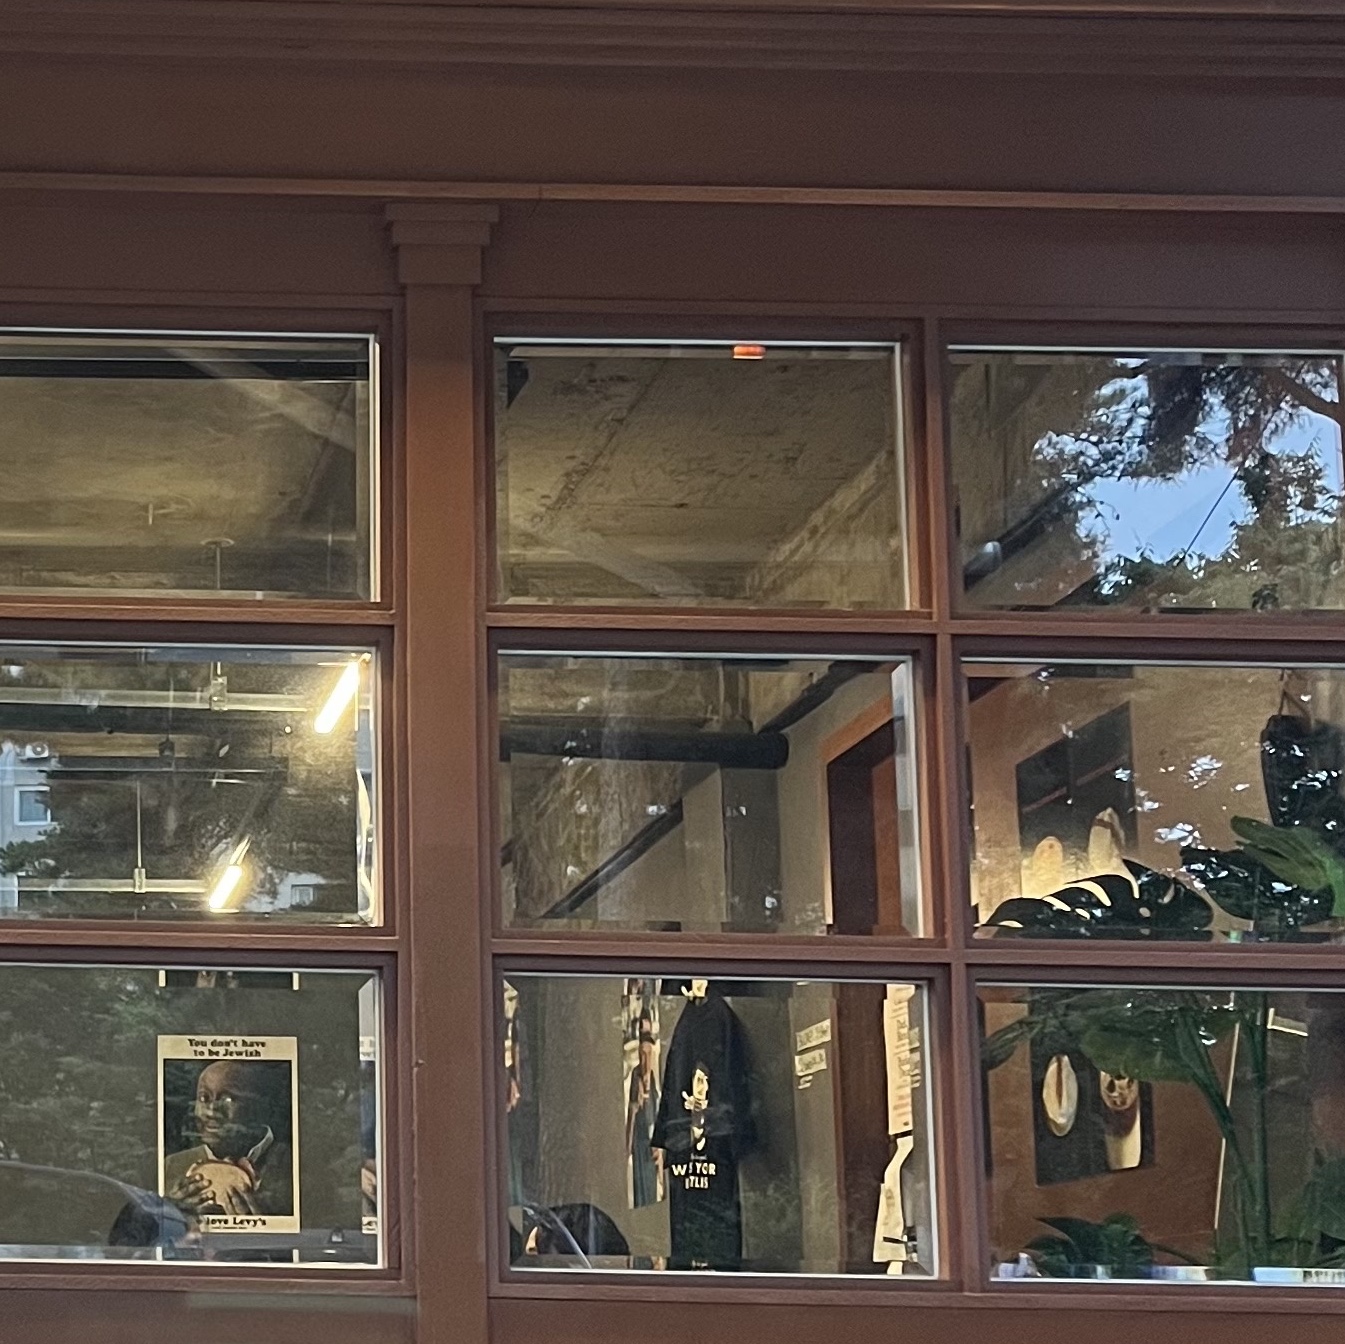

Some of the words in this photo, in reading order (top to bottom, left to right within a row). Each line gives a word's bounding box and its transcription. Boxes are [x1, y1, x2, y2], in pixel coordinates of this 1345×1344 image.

[187, 1038, 207, 1047] You
[211, 1038, 238, 1047] don't
[242, 1039, 266, 1048] have
[194, 1049, 205, 1057] to
[208, 1049, 220, 1057] be
[223, 1049, 261, 1057] Jewish
[233, 1217, 267, 1227] Levy's
